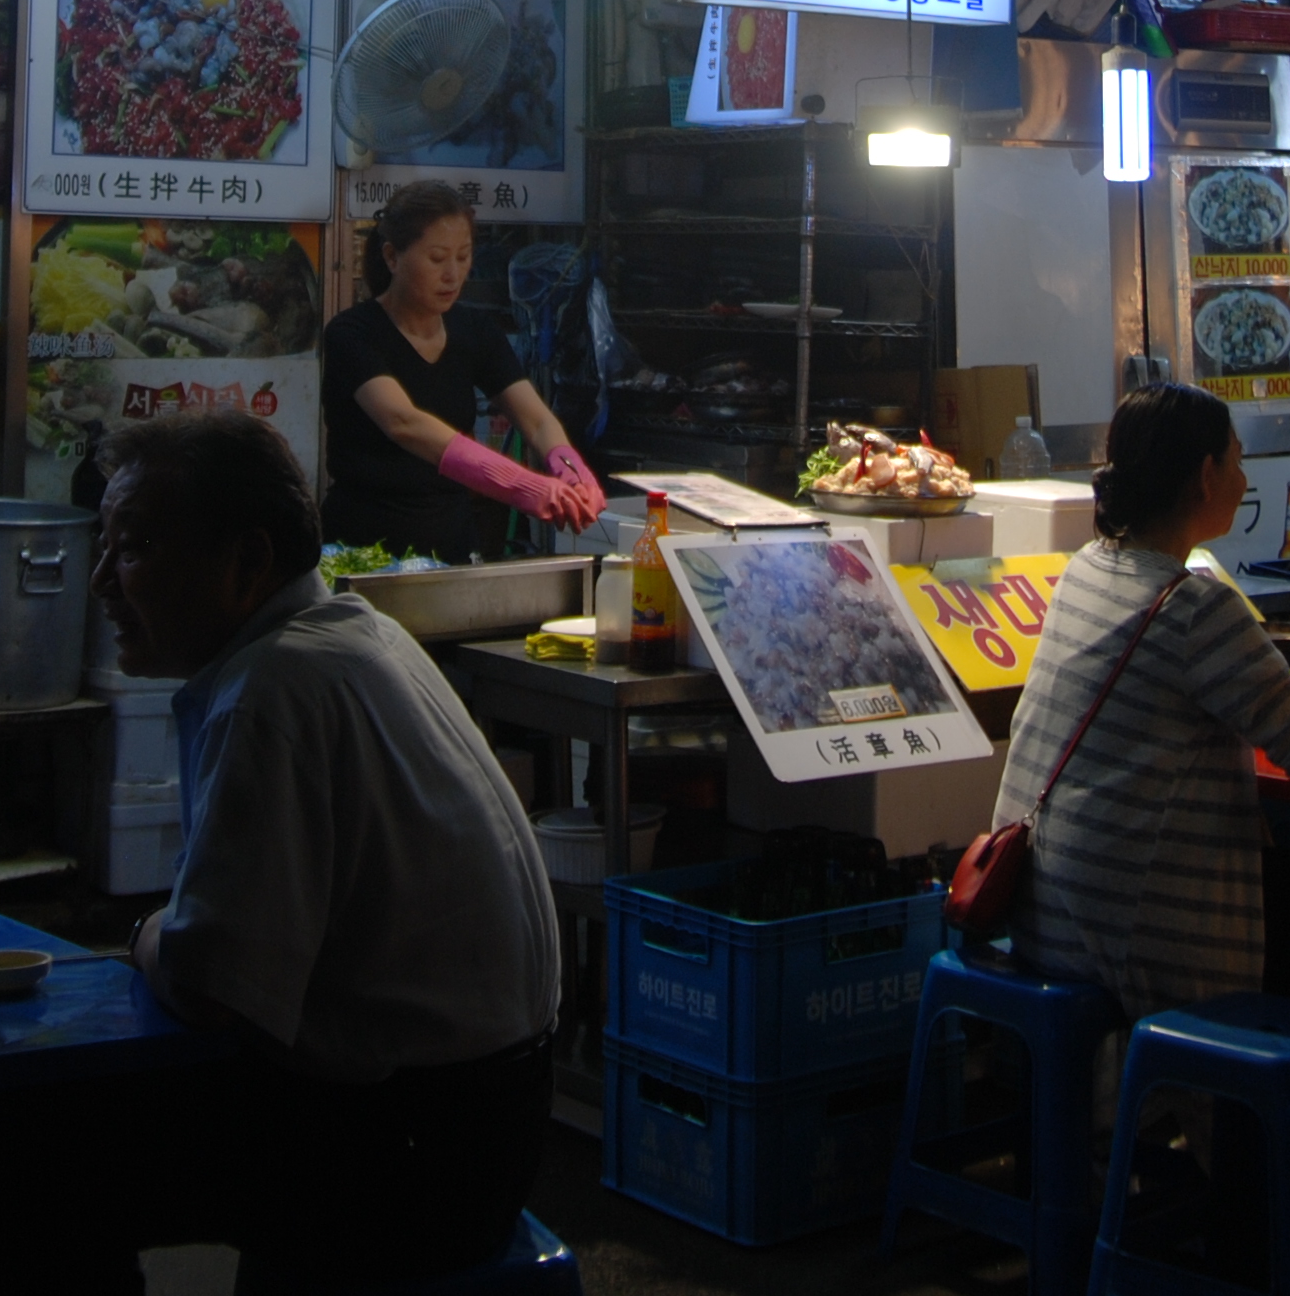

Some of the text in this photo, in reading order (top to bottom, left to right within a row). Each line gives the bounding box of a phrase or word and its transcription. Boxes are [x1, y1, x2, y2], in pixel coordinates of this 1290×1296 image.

[1195, 256, 1241, 278] 산낙지
[919, 573, 1060, 670] 생대
[637, 971, 717, 1021] 하이트진로
